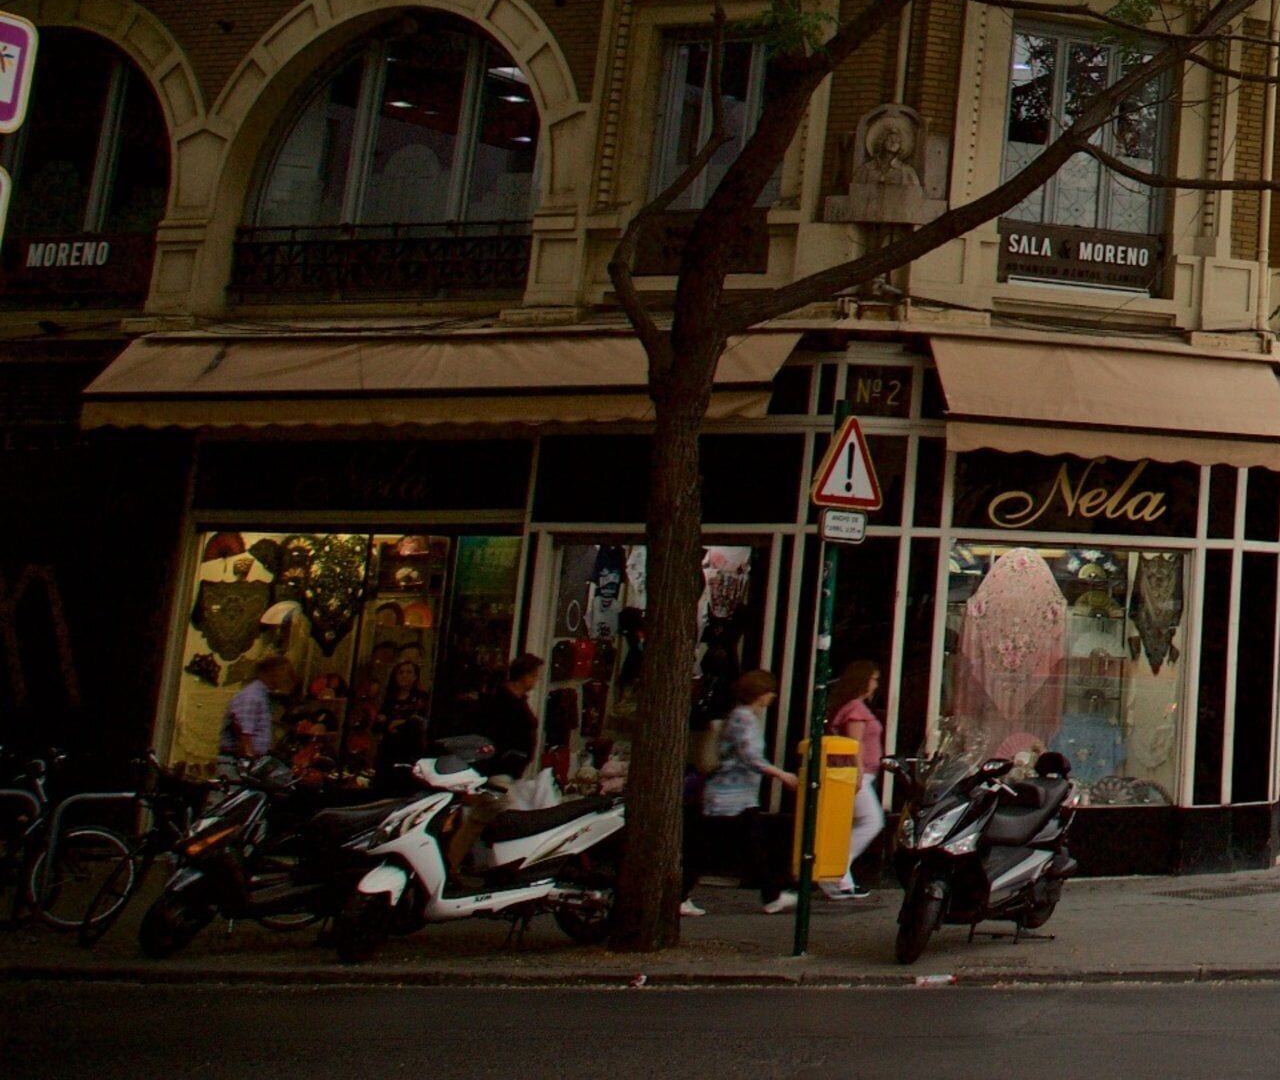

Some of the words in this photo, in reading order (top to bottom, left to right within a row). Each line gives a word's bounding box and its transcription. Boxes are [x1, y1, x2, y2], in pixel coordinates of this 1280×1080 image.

[26, 242, 110, 267] MORENO
[1009, 233, 1052, 257] SALA
[1079, 241, 1149, 267] MORENO
[886, 379, 902, 406] 2
[988, 456, 1167, 528] Nela
